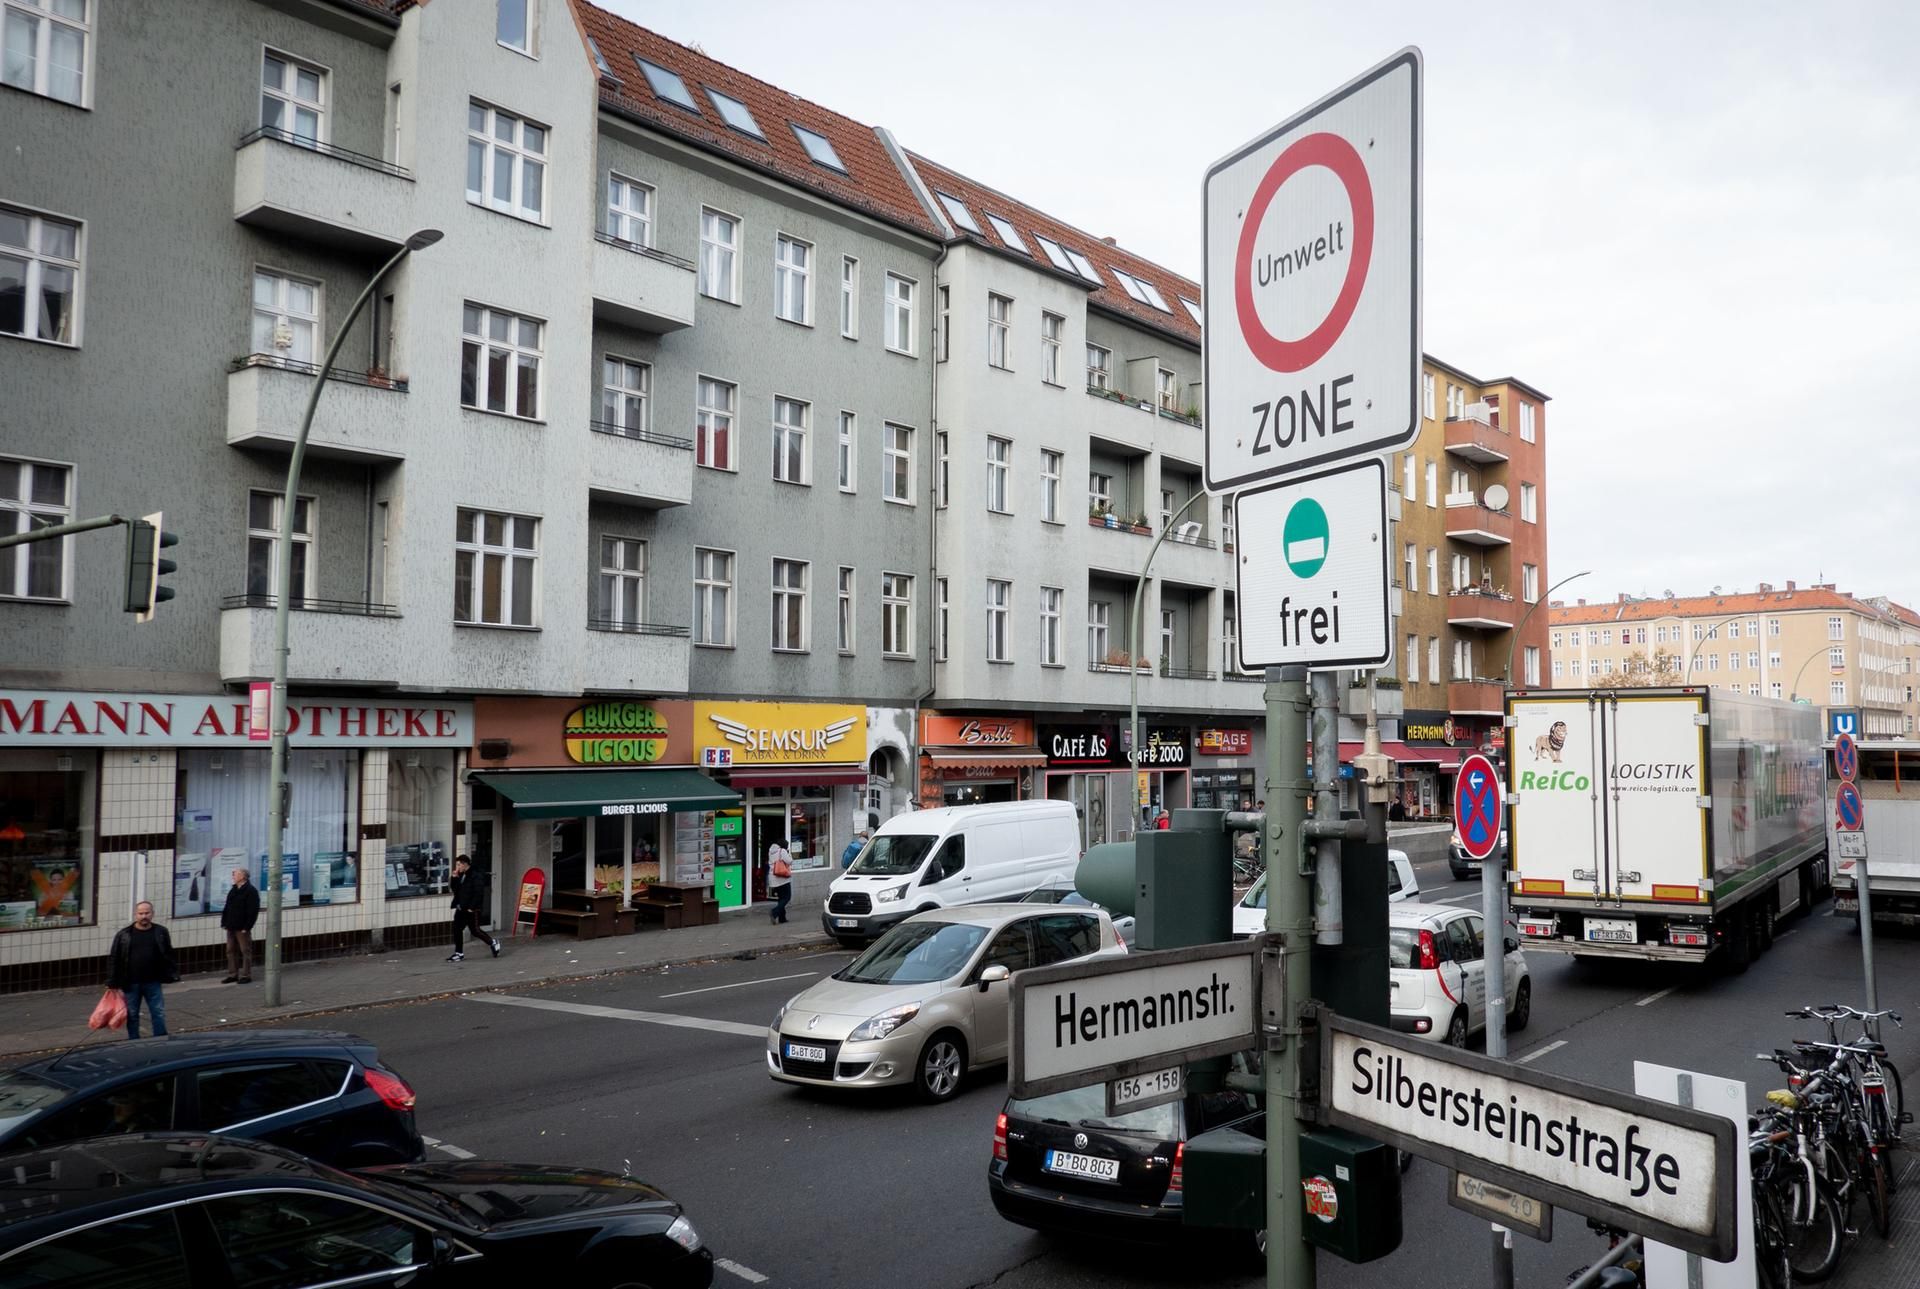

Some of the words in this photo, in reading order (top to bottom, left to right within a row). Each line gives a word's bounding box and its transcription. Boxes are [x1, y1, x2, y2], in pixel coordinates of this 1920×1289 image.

[1258, 221, 1343, 287] Umwelt
[1252, 373, 1354, 456] ZONE
[1279, 590, 1339, 647] frei
[583, 702, 657, 729] BURGER
[746, 729, 828, 751] SEMSUR
[1407, 725, 1444, 740] HERMANN
[583, 739, 657, 763] LICIOUS
[744, 751, 779, 760] TABAX
[783, 751, 790, 760] &
[1159, 746, 1184, 762] 2000
[1520, 770, 1589, 791] ReiCo
[1610, 763, 1696, 780] LOGISTIK
[1610, 785, 1698, 793] www.reico-logistik.com
[601, 804, 635, 815] BURGER
[636, 803, 668, 814] LICIOUS
[1055, 972, 1235, 1048] Hermannstr.
[1351, 1046, 1681, 1198] Silbersteinstraße
[1071, 1155, 1088, 1170] BQ
[1090, 1158, 1114, 1175] 803
